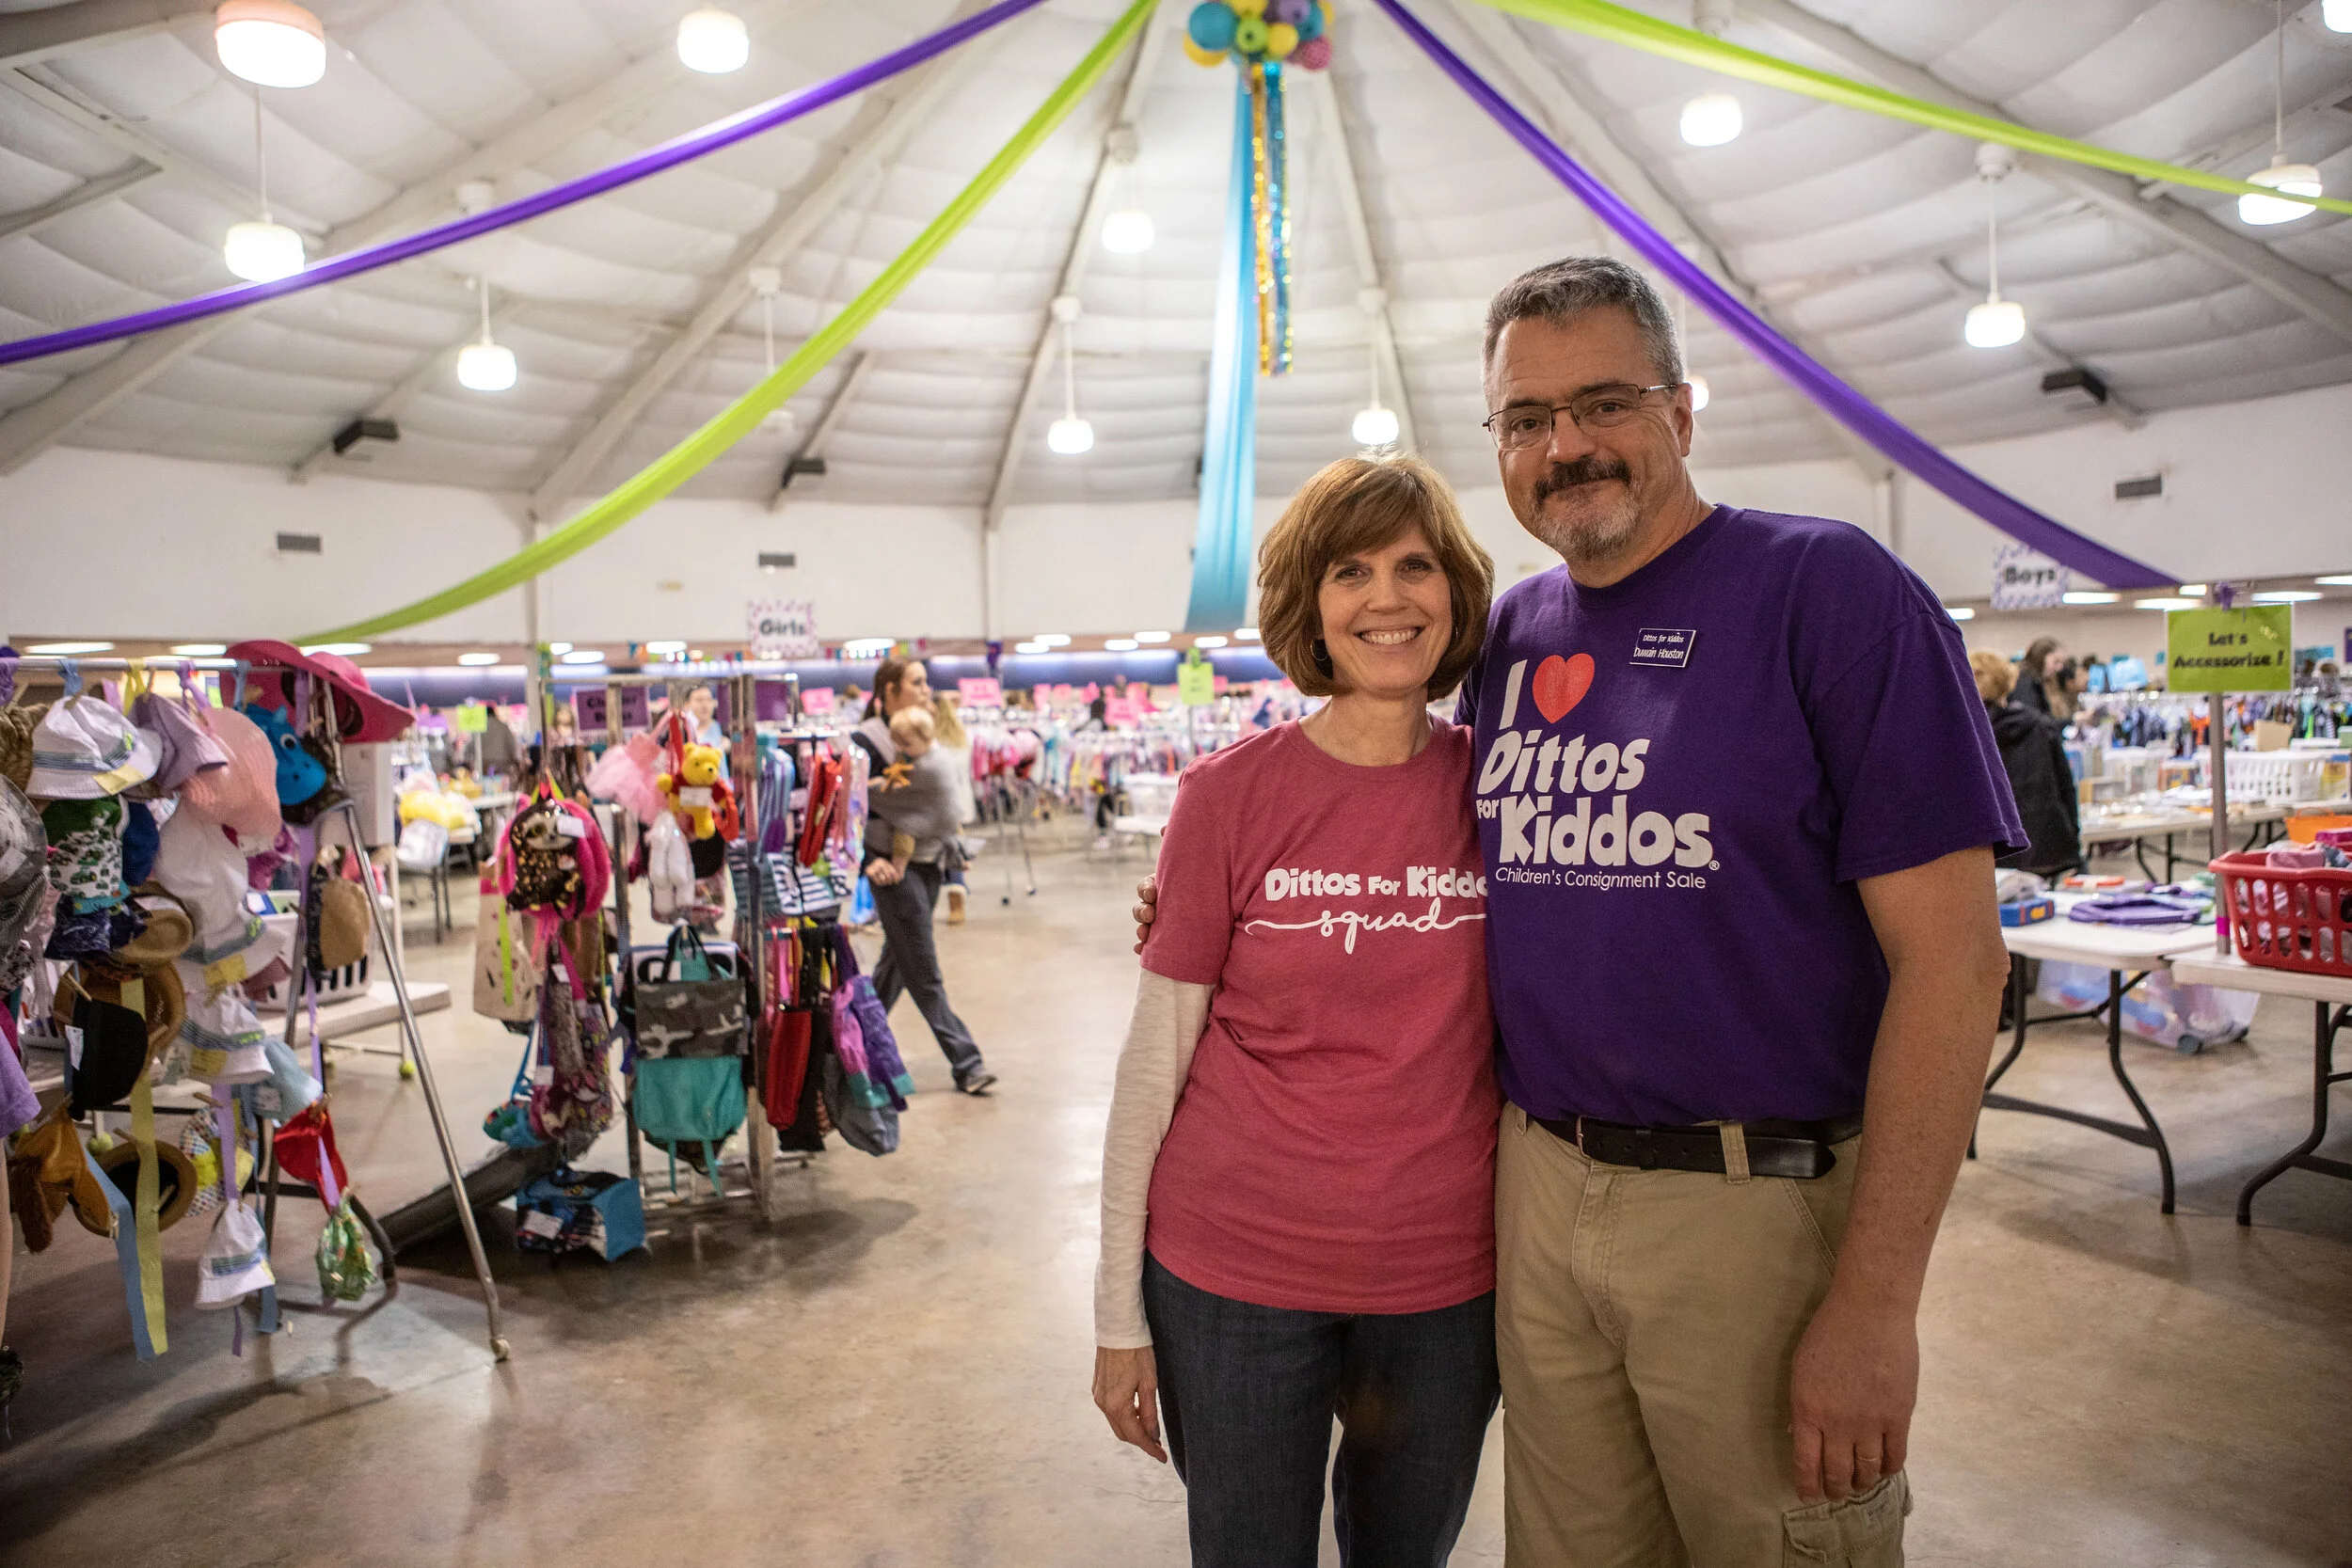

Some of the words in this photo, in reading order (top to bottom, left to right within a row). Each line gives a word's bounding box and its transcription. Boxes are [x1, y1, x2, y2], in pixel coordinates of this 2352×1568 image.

[2005, 565, 2056, 587] Boys
[759, 618, 806, 637] Girls
[1658, 634, 1667, 644] for
[2208, 633, 2249, 646] Let's
[1658, 648, 1684, 659] Houston
[1499, 659, 1528, 730] I
[1477, 729, 1651, 795] Dittos
[1264, 867, 1361, 901] Dittos
[1368, 876, 1401, 896] For
[1406, 865, 1488, 897] Kiddo
[1495, 867, 1562, 885] Children's
[1565, 869, 1661, 891] Consignment
[1666, 871, 1707, 889] Sale
[1320, 896, 1486, 955] squad
